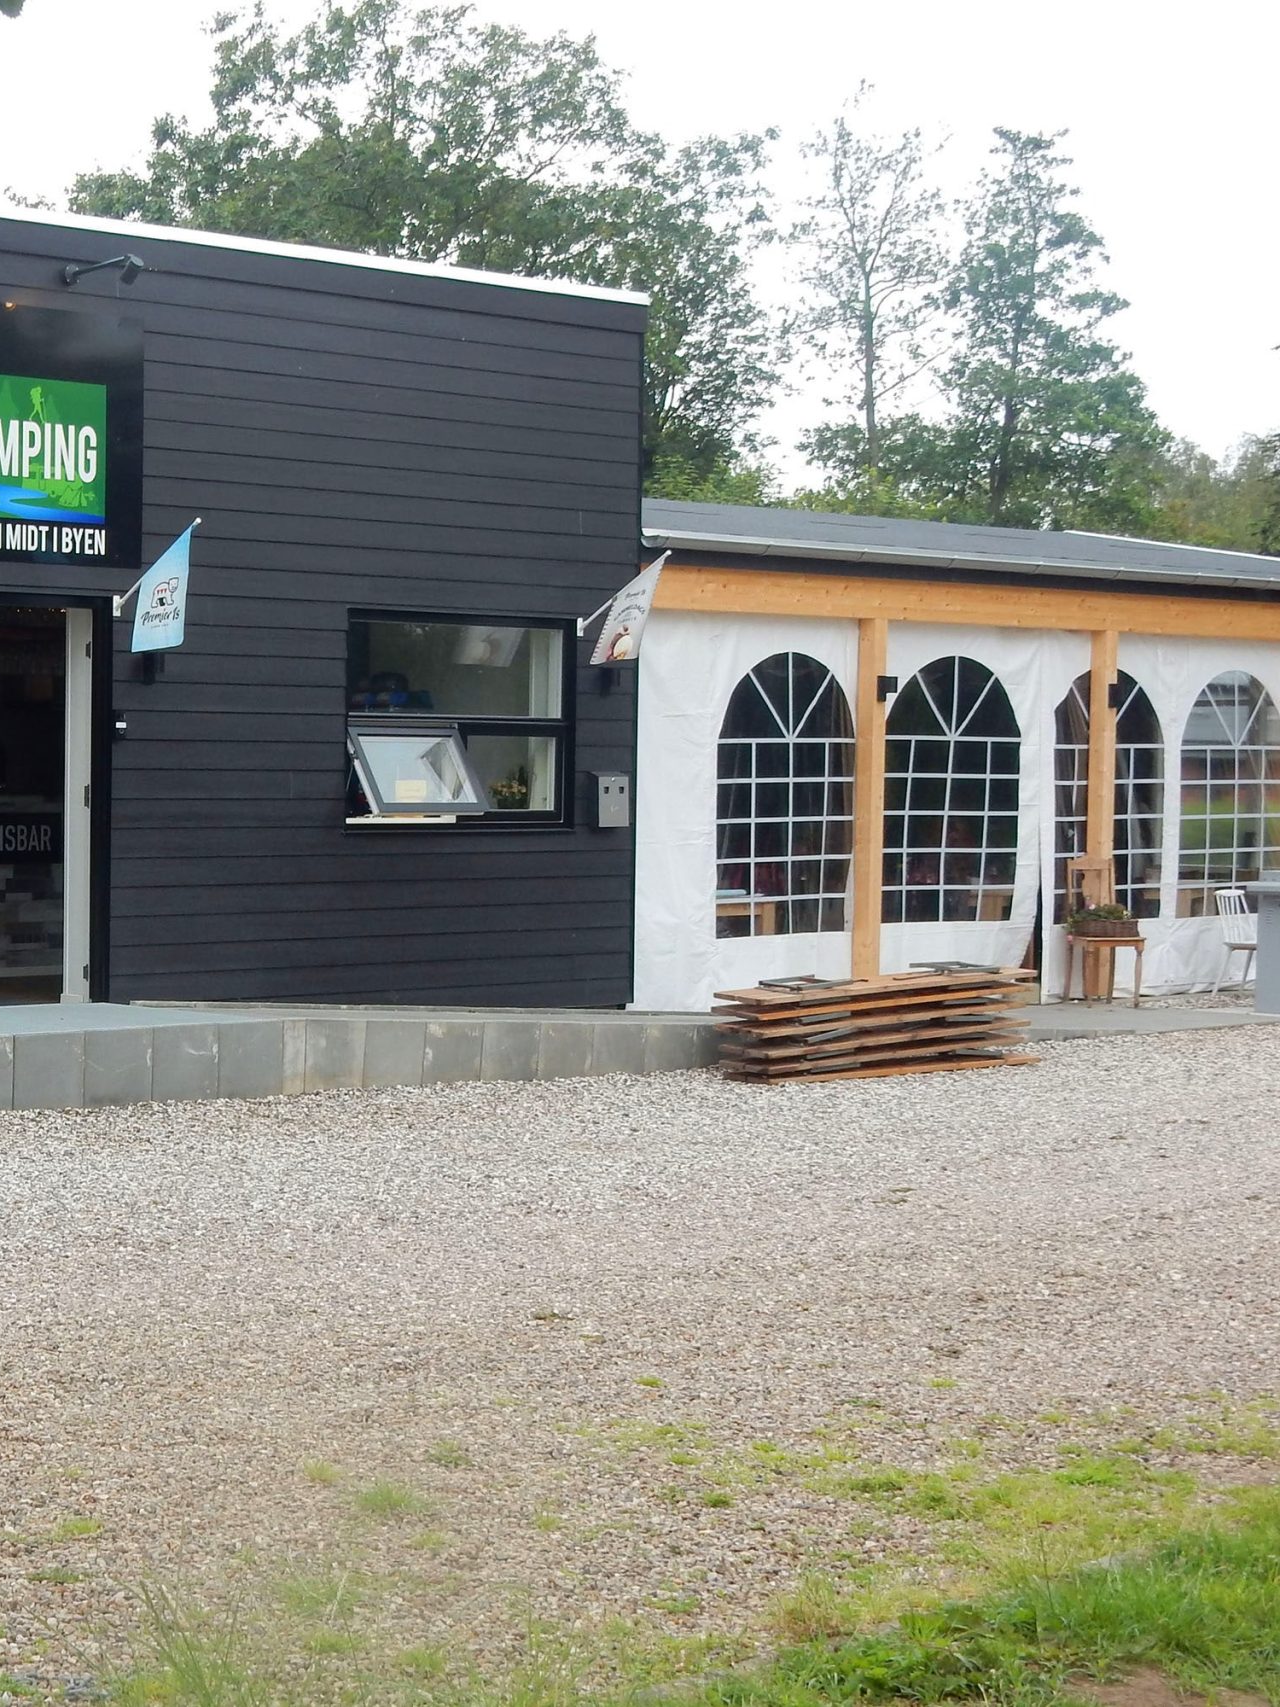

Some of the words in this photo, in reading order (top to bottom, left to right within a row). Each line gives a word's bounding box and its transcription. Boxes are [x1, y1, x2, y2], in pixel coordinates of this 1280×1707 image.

[6, 523, 49, 552] MIDT
[52, 526, 58, 553] I
[61, 527, 106, 556] BYEN
[140, 607, 172, 626] Premier
[0, 824, 52, 852] ISBAR
